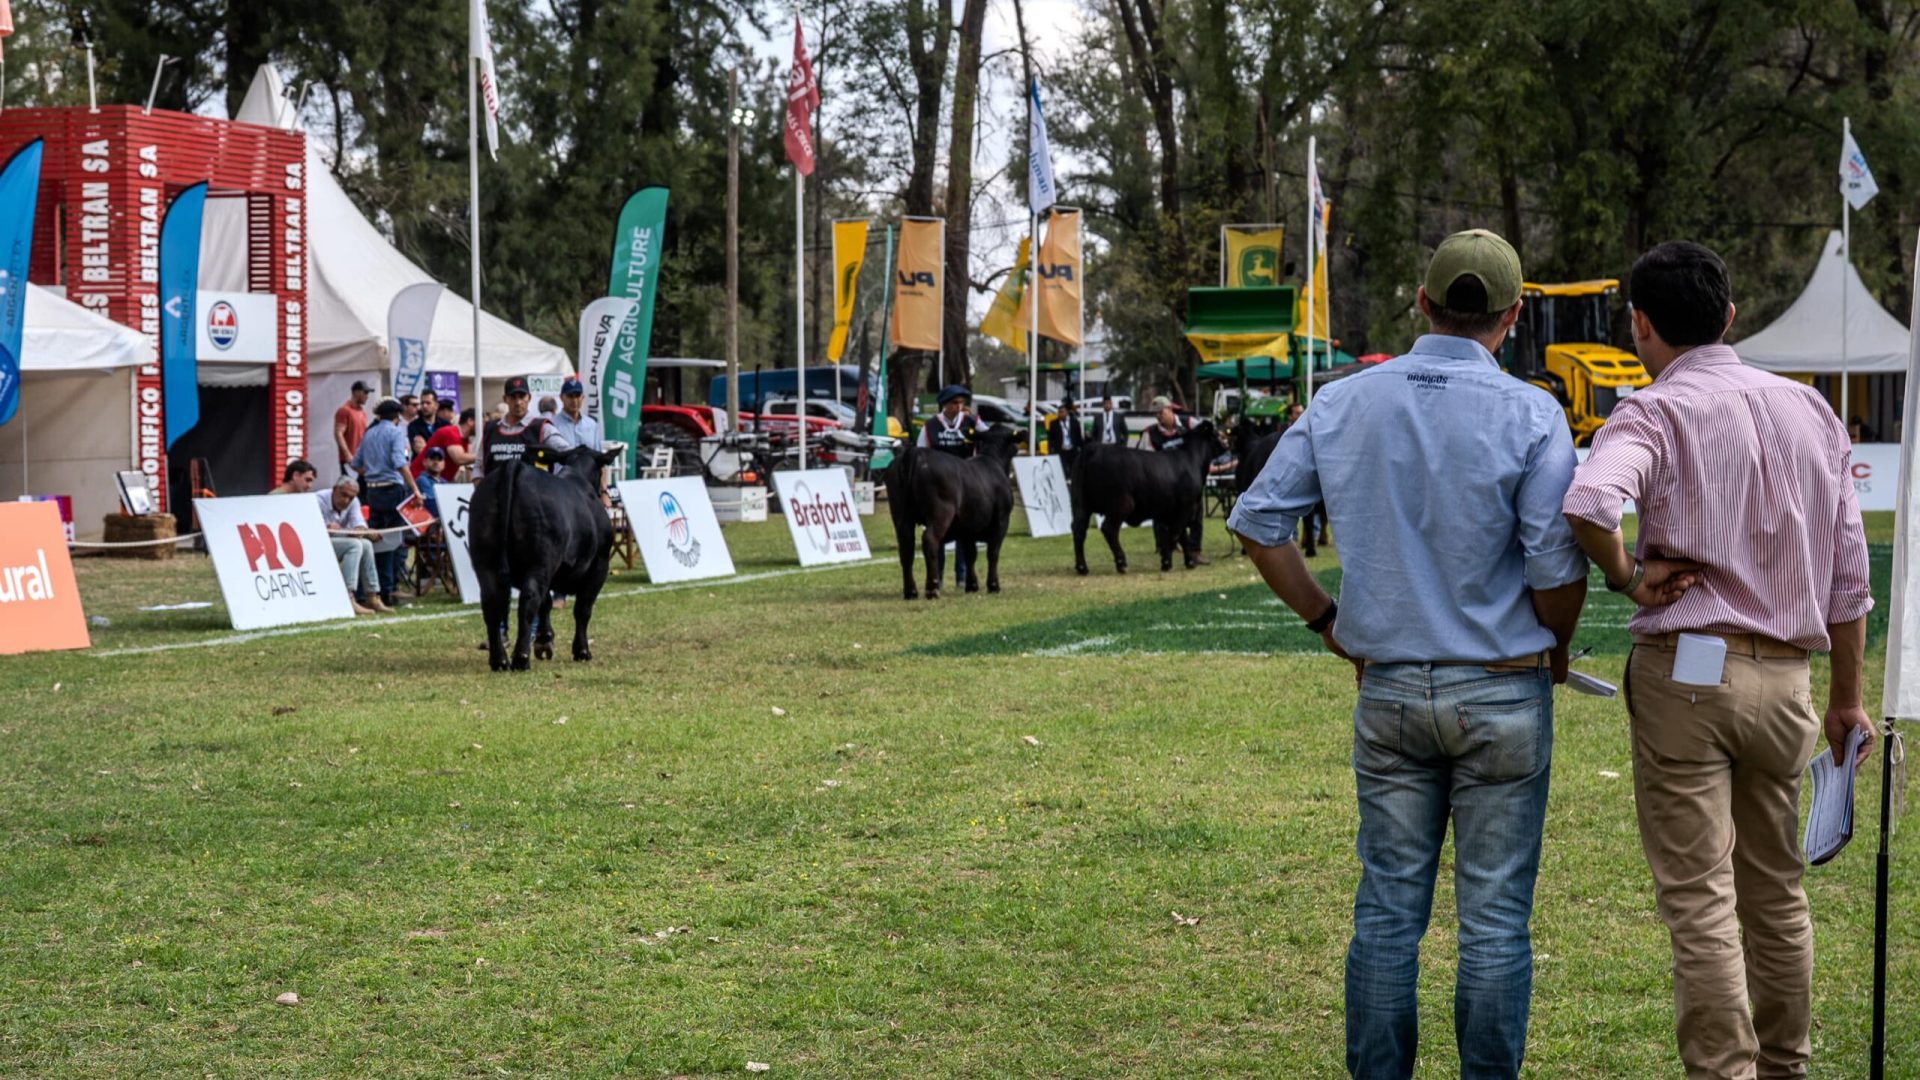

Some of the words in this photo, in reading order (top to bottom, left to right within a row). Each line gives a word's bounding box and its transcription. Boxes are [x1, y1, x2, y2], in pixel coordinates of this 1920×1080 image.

[82, 139, 109, 173] SA
[139, 145, 158, 178] SA
[285, 162, 303, 190] SA
[82, 182, 109, 282] BELTRAN
[140, 188, 159, 282] BELTRAN
[285, 197, 303, 290] BELTRAN
[619, 226, 651, 365] AGRICULTURE
[285, 300, 302, 378] FORRES
[790, 491, 853, 539] Braford
[255, 571, 316, 601] CARNE
